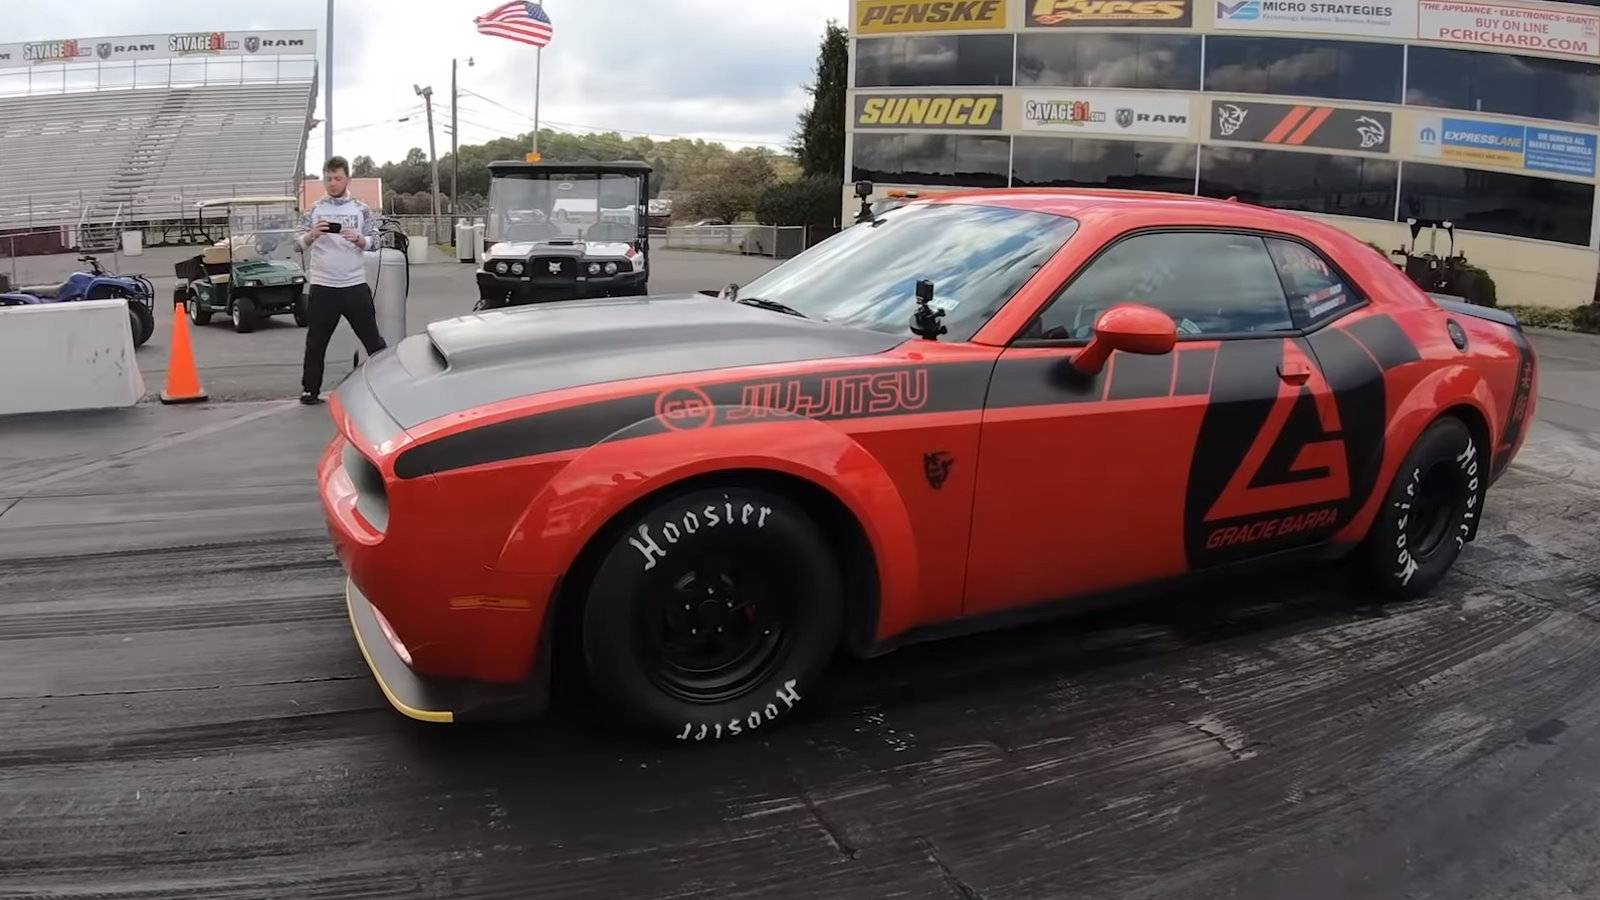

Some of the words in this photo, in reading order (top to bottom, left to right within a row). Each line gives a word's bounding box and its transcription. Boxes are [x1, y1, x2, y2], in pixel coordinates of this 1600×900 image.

[860, 0, 1000, 27] PENSKE
[1263, 2, 1306, 12] MICRO
[1310, 3, 1393, 17] STRATEGIES
[1442, 4, 1491, 15] APPLIANCE
[1475, 17, 1500, 29] BUY
[1502, 19, 1521, 31] ON
[1523, 21, 1549, 34] LINE
[114, 44, 155, 52] RAM
[1439, 27, 1588, 52] PCRICHARD.COM
[859, 97, 997, 125] SUNOCO
[1136, 113, 1187, 124] RAM
[726, 369, 928, 420] JIU-JITSU
[628, 493, 772, 571] Hoosier
[1205, 519, 1278, 550] GRACIE
[1277, 508, 1339, 537] BARRA
[676, 678, 801, 741] Hoosier
